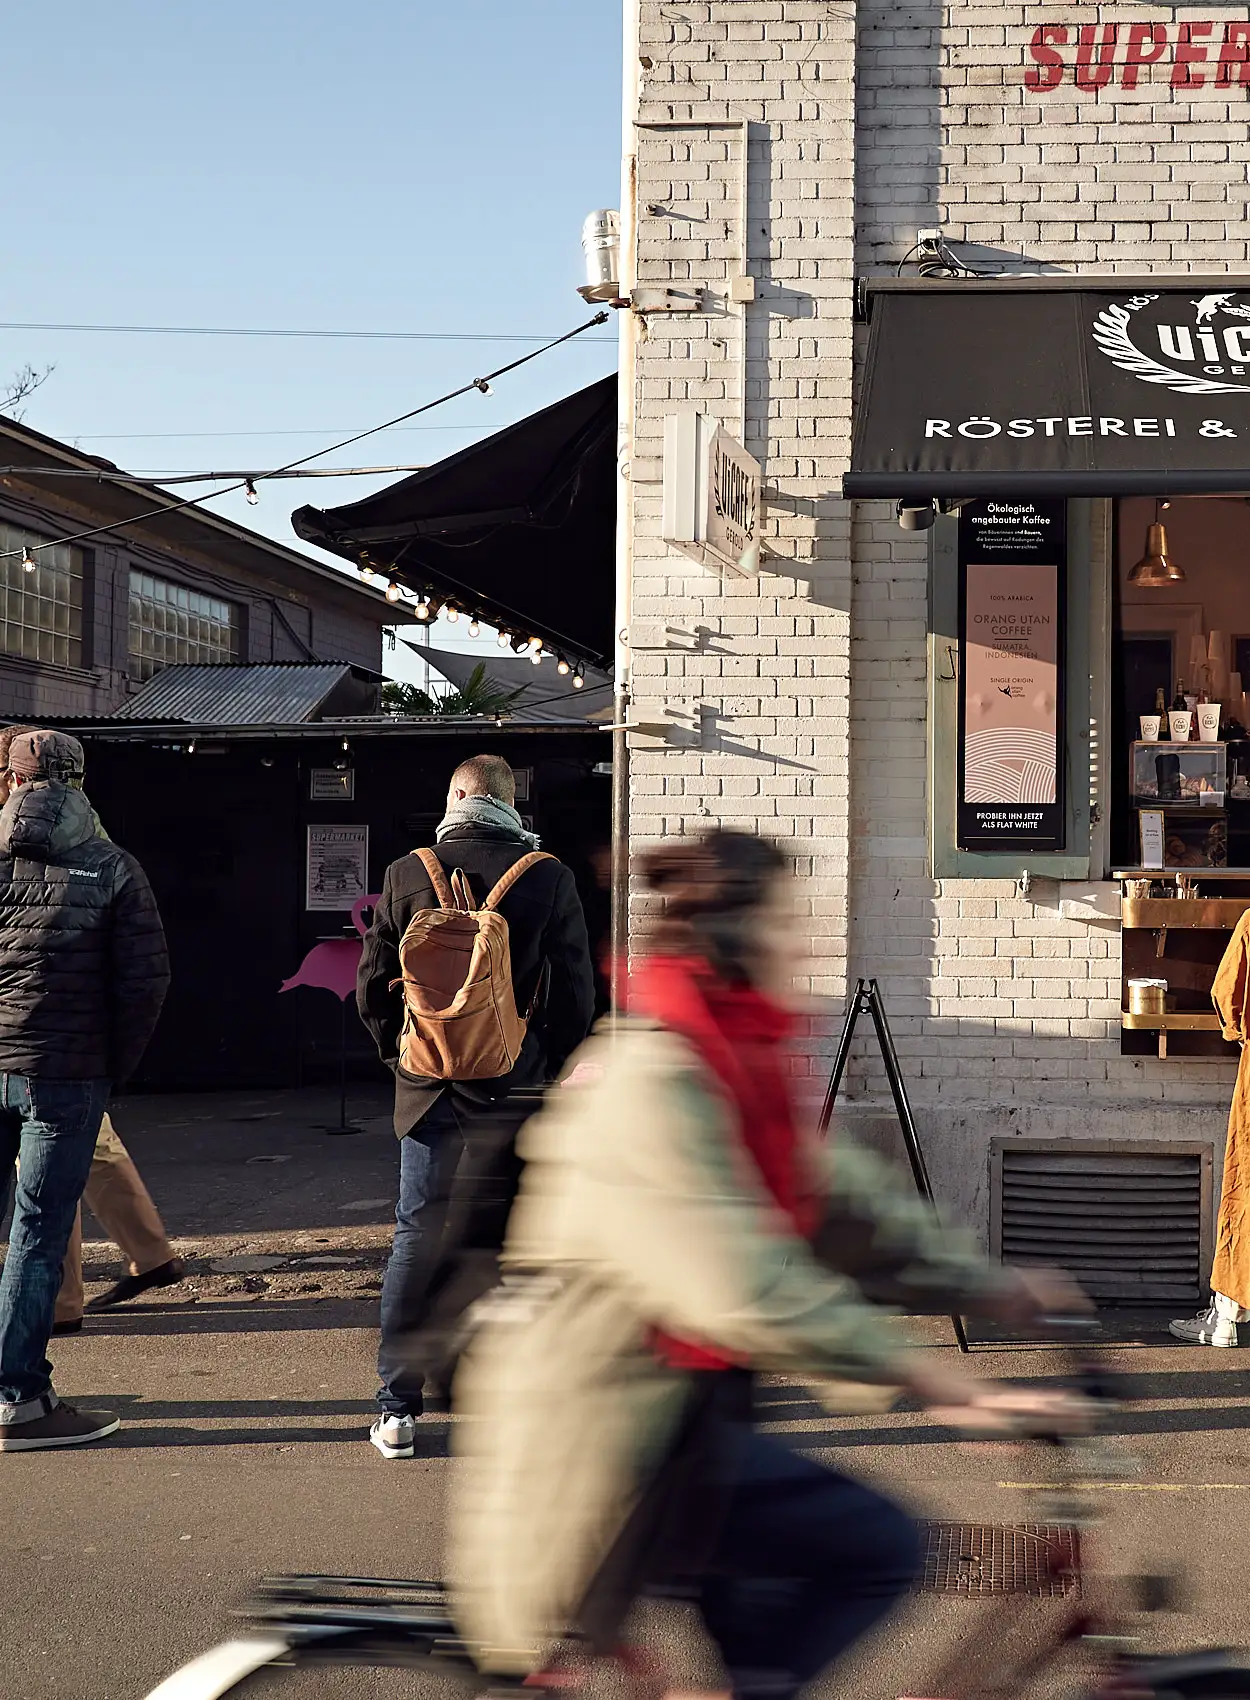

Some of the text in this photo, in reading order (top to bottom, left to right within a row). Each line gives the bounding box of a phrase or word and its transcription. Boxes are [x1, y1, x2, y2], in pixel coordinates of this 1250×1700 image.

[924, 415, 1176, 440] RÖSTEREI
[1197, 419, 1237, 439] &
[987, 502, 1035, 515] Ökologisch
[971, 514, 1051, 526] angebauter Kaffee
[973, 614, 1050, 624] ORANG UTAN
[991, 625, 1032, 635] COFFEE
[985, 651, 1038, 659] INDONESIEN
[976, 812, 1044, 820] PROBIER IHN JETZT
[981, 821, 1038, 829] ALS FLAT WHITE
